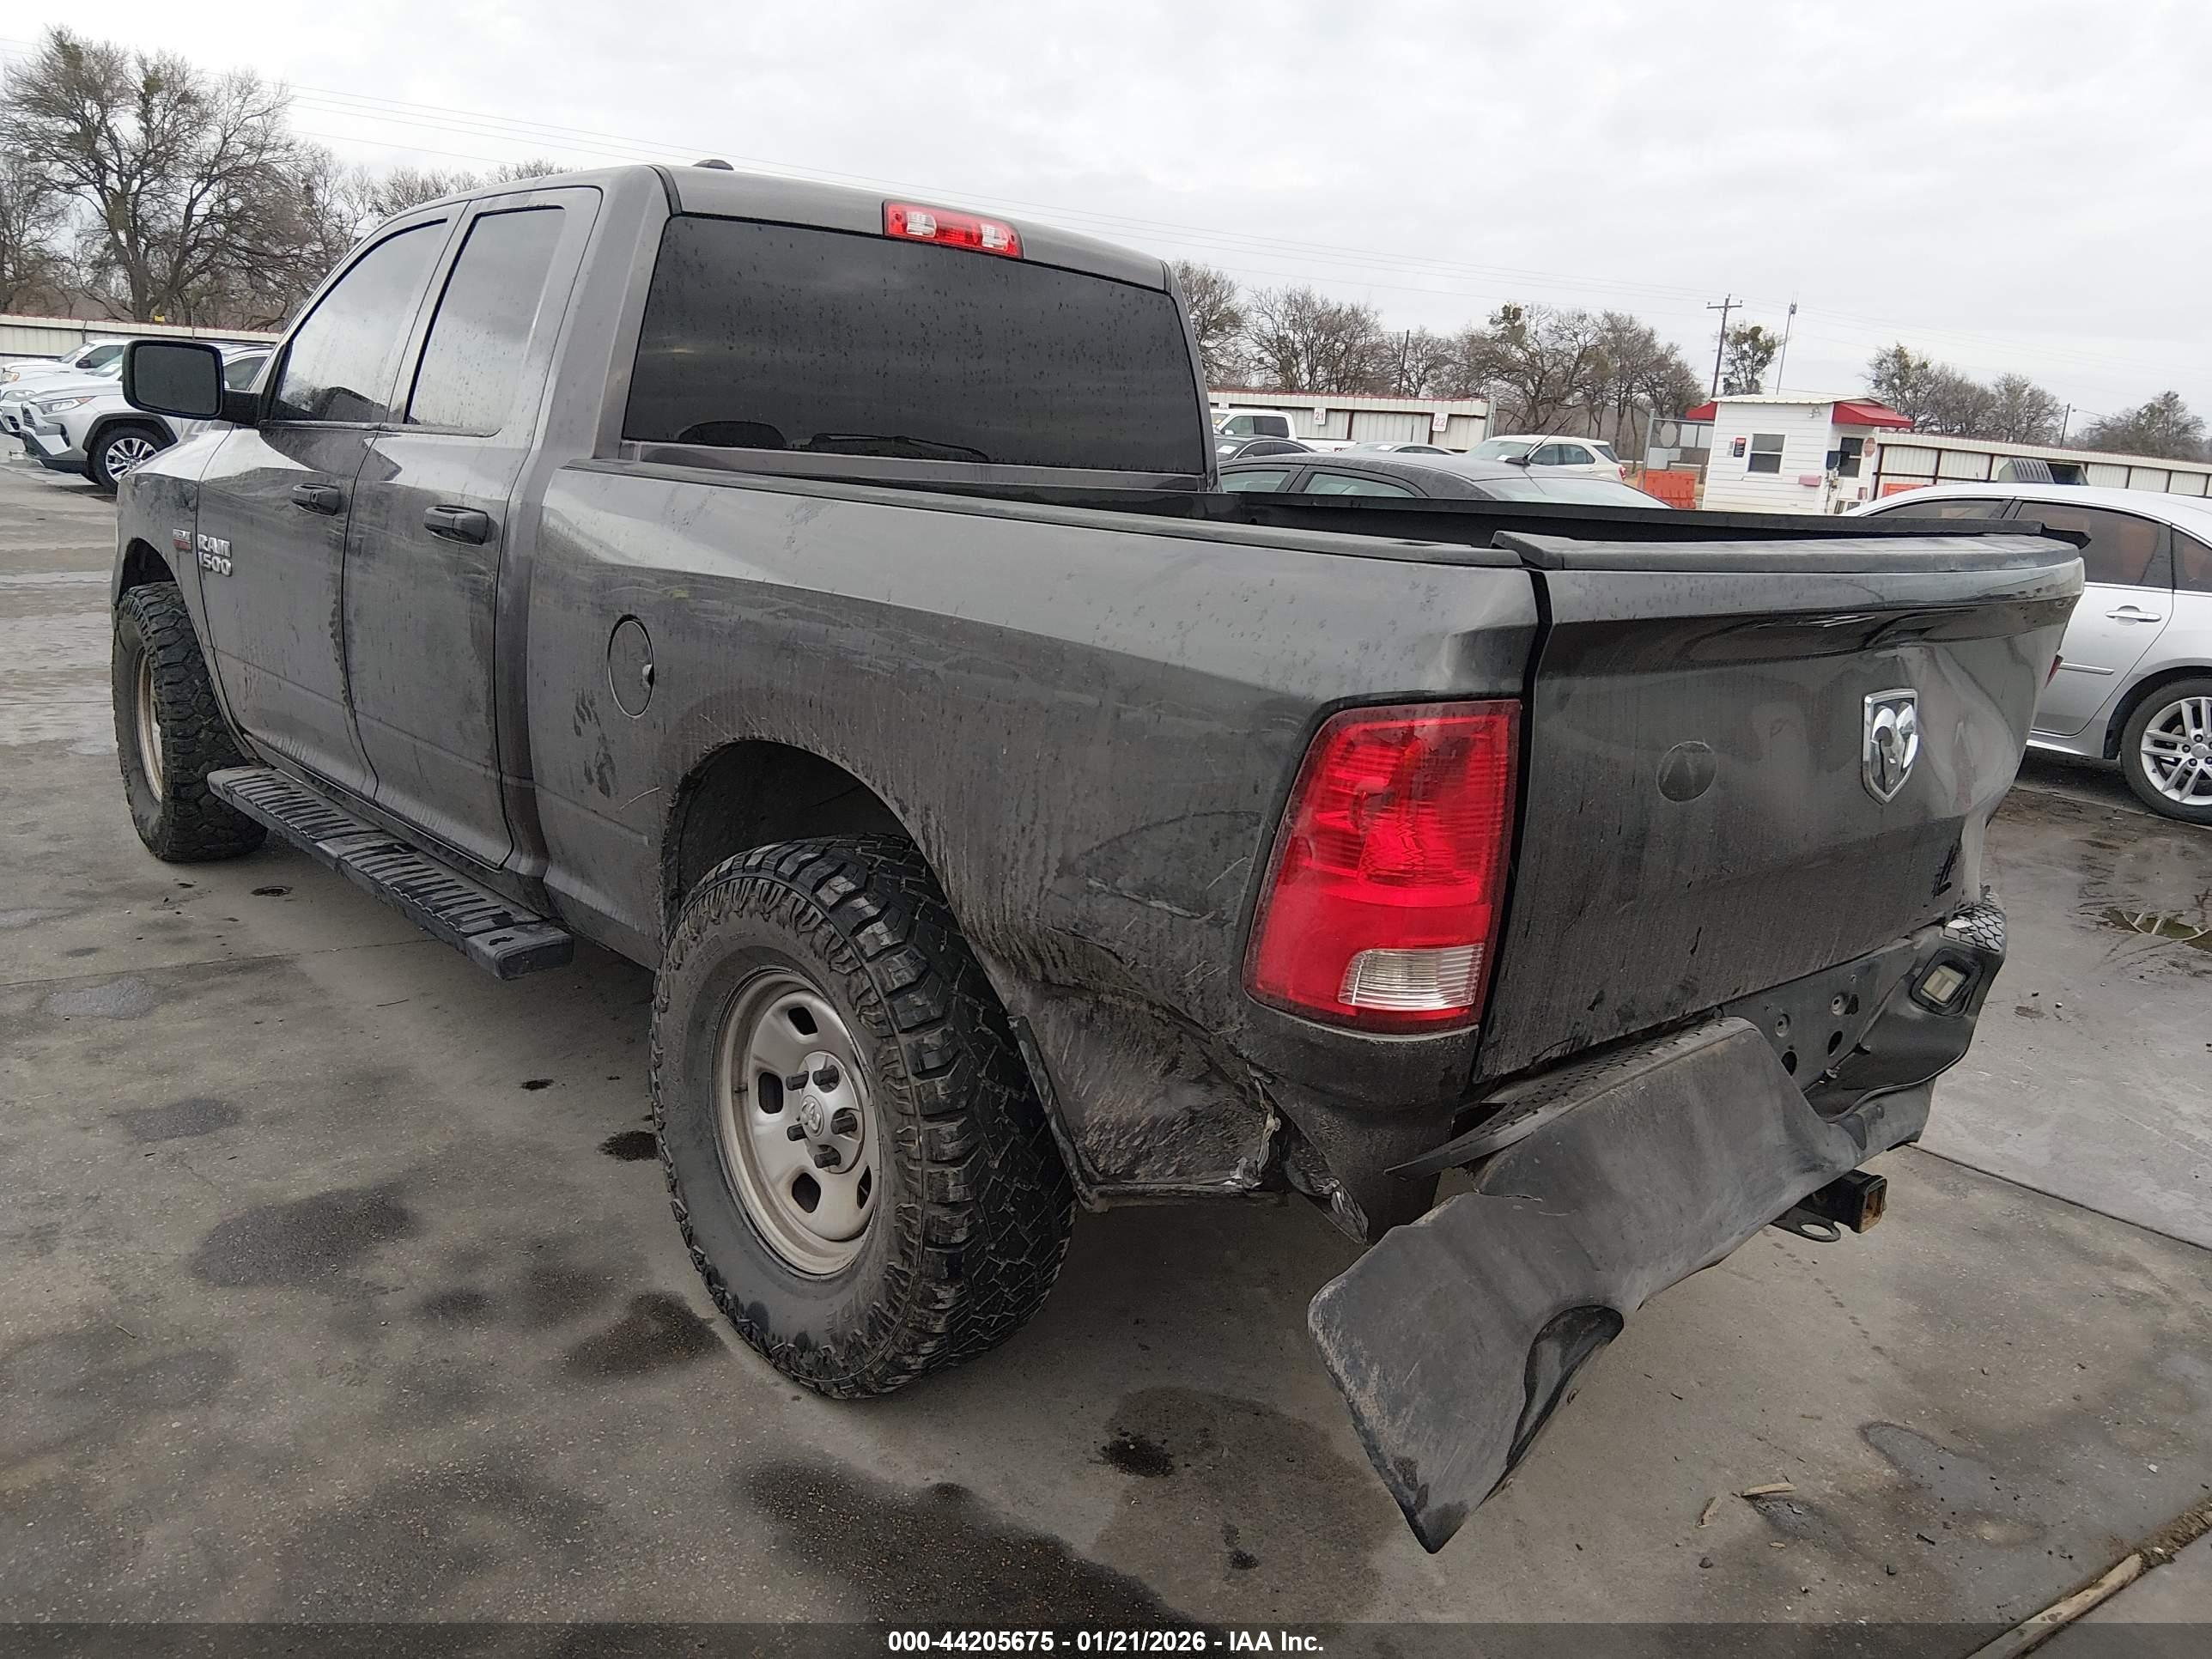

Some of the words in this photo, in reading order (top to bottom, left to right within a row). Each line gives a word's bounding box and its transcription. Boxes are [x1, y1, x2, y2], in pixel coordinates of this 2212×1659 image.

[1315, 412, 1324, 421] 21
[1435, 416, 1446, 427] 22
[198, 534, 232, 557] RAM
[198, 551, 233, 576] 1500
